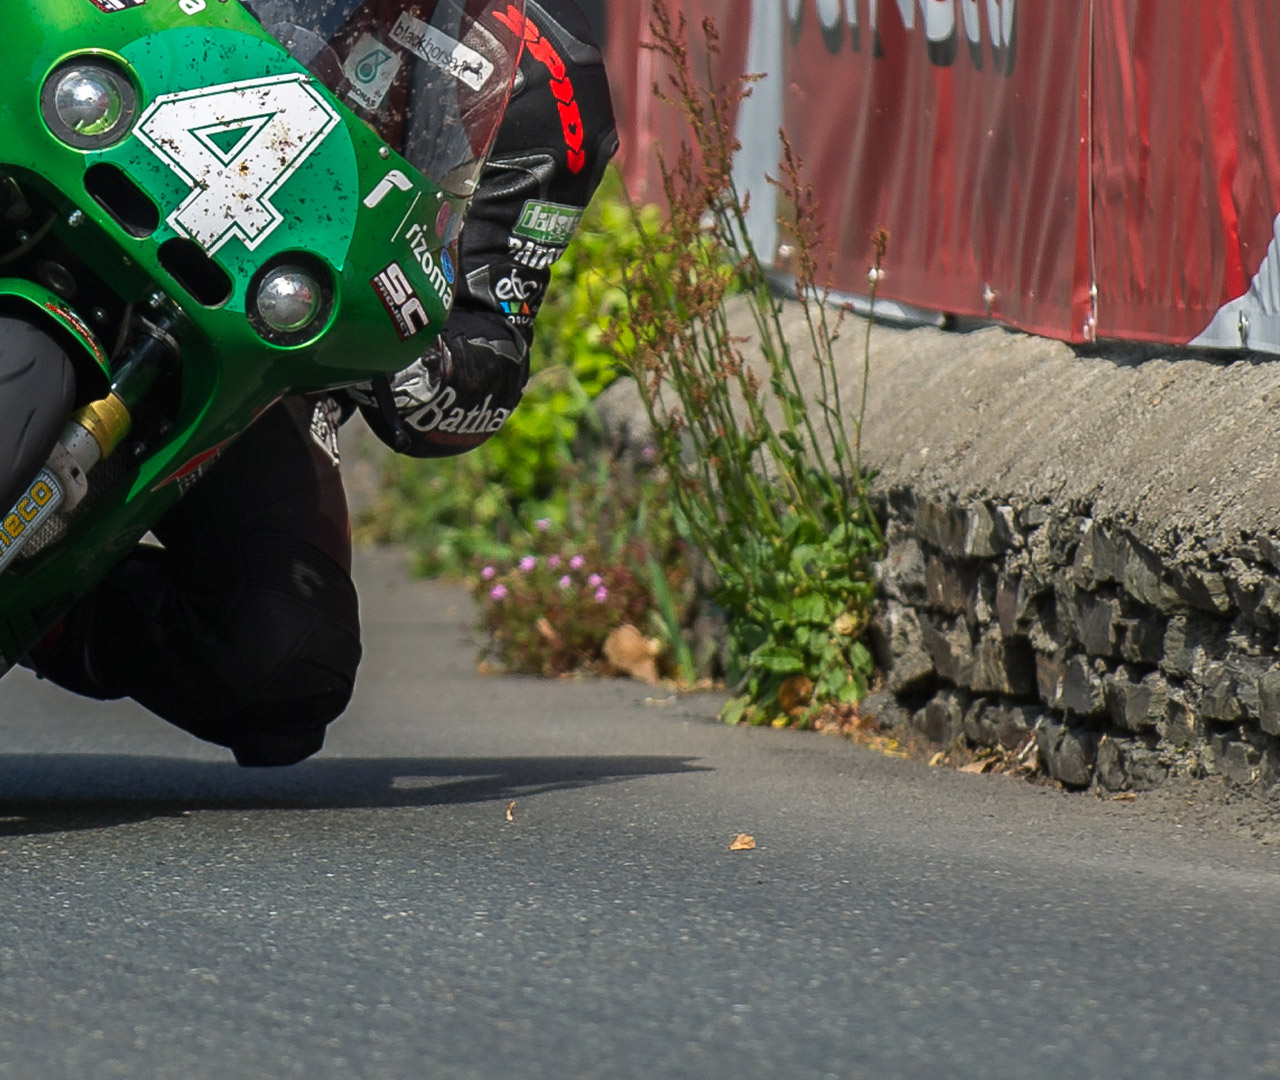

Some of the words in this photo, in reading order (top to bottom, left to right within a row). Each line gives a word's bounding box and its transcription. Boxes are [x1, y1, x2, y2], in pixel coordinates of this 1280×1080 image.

[393, 22, 457, 69] blackhorse
[132, 73, 341, 258] 4
[379, 263, 430, 335] SC
[405, 223, 453, 311] rizoma
[373, 276, 410, 338] PROJECT
[405, 381, 511, 434] Batha
